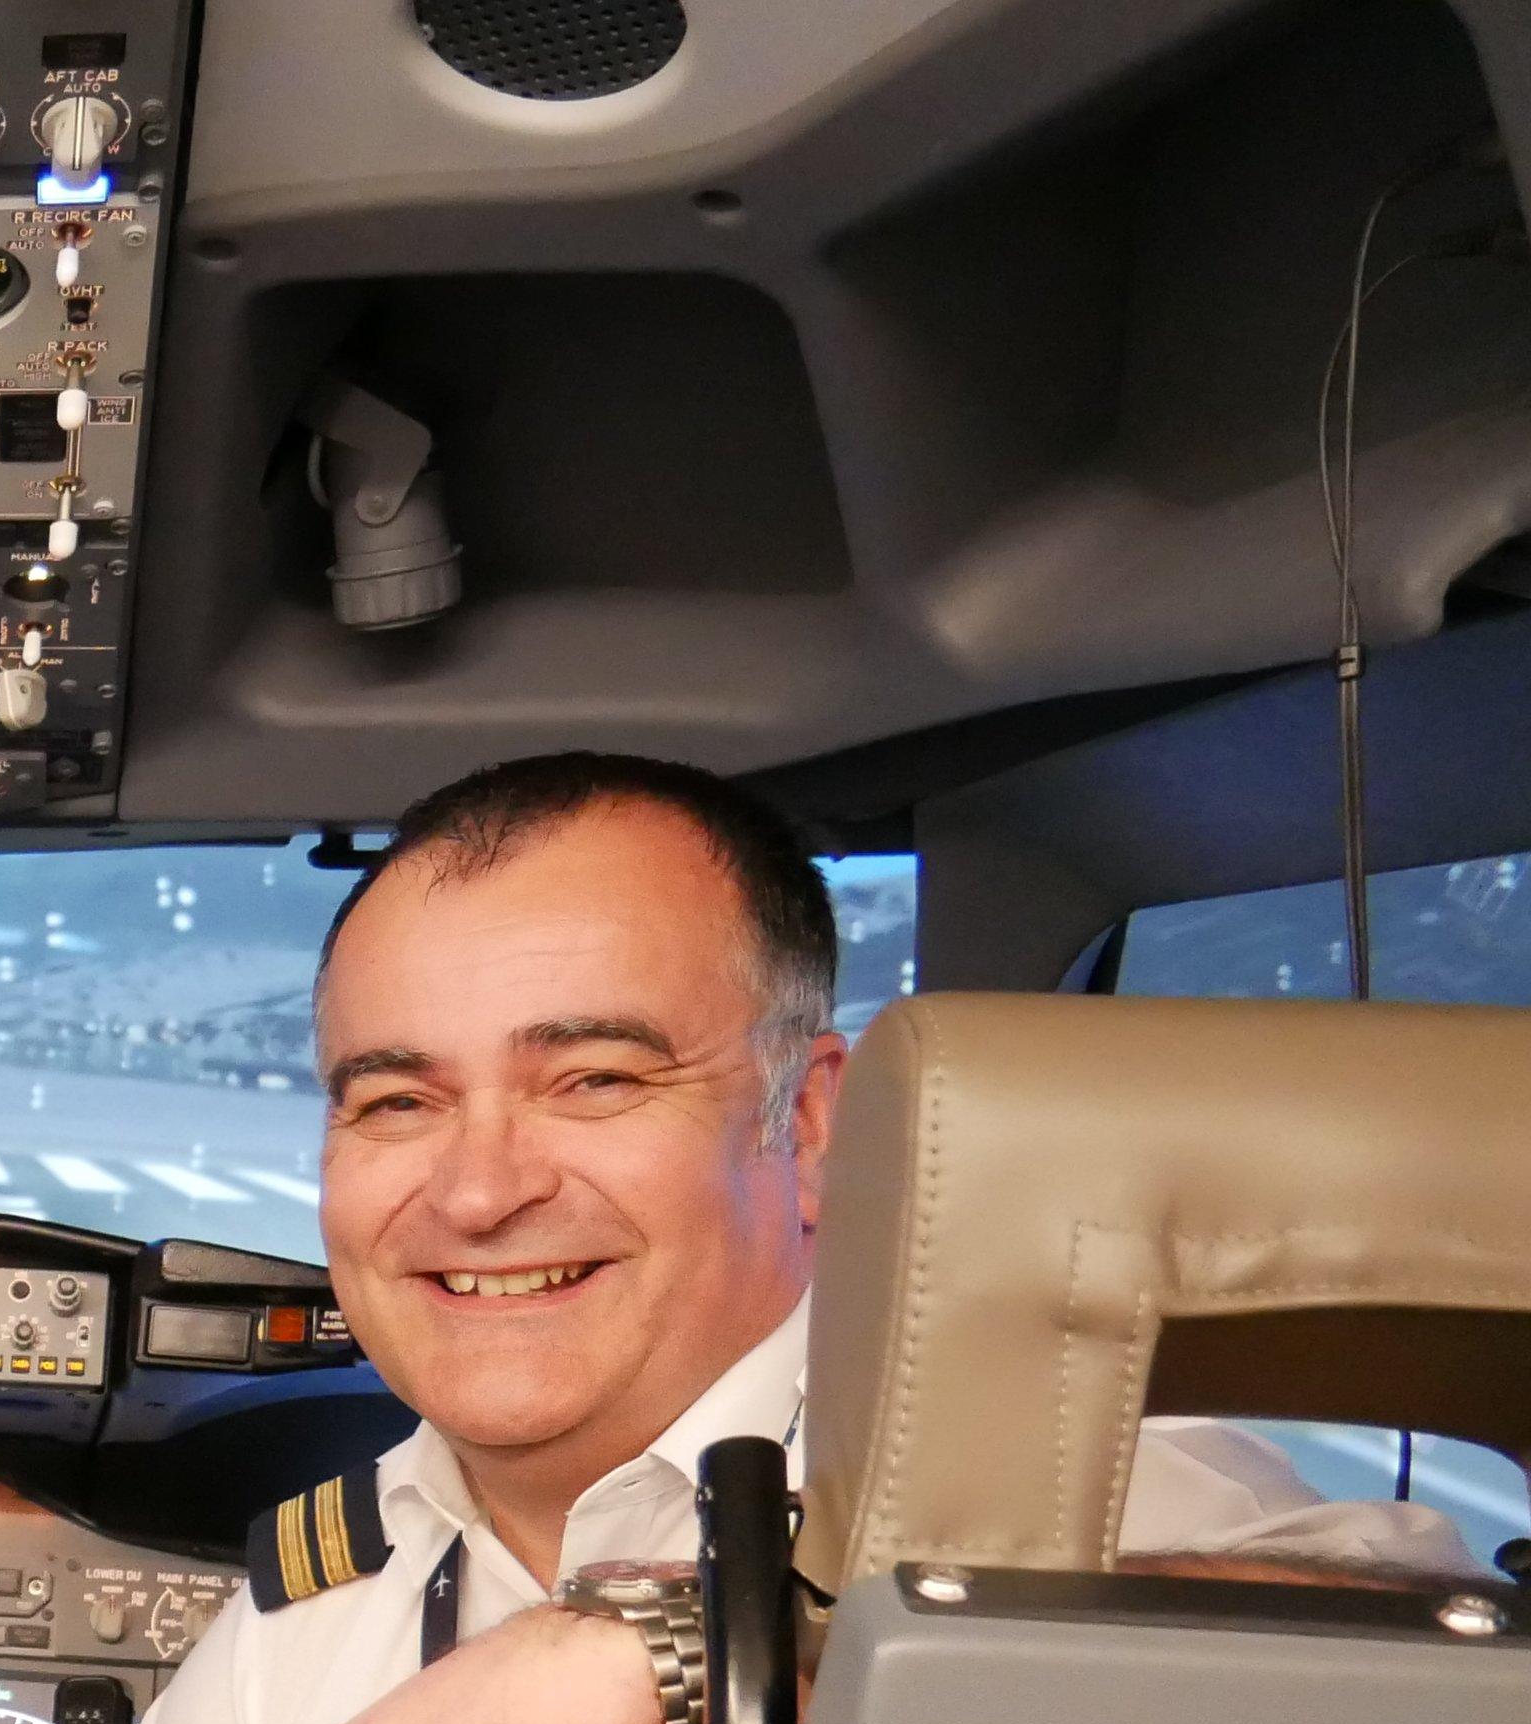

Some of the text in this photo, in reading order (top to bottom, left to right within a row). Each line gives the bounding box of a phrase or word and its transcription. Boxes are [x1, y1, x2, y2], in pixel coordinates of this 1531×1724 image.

[44, 69, 119, 83] AFT CAB
[63, 82, 101, 93] AUTO
[59, 286, 105, 296] OVHT
[61, 322, 97, 332] TEST
[96, 399, 128, 409] WING
[85, 1568, 123, 1581] LOWER
[157, 1573, 225, 1587] MAIN PANEL
